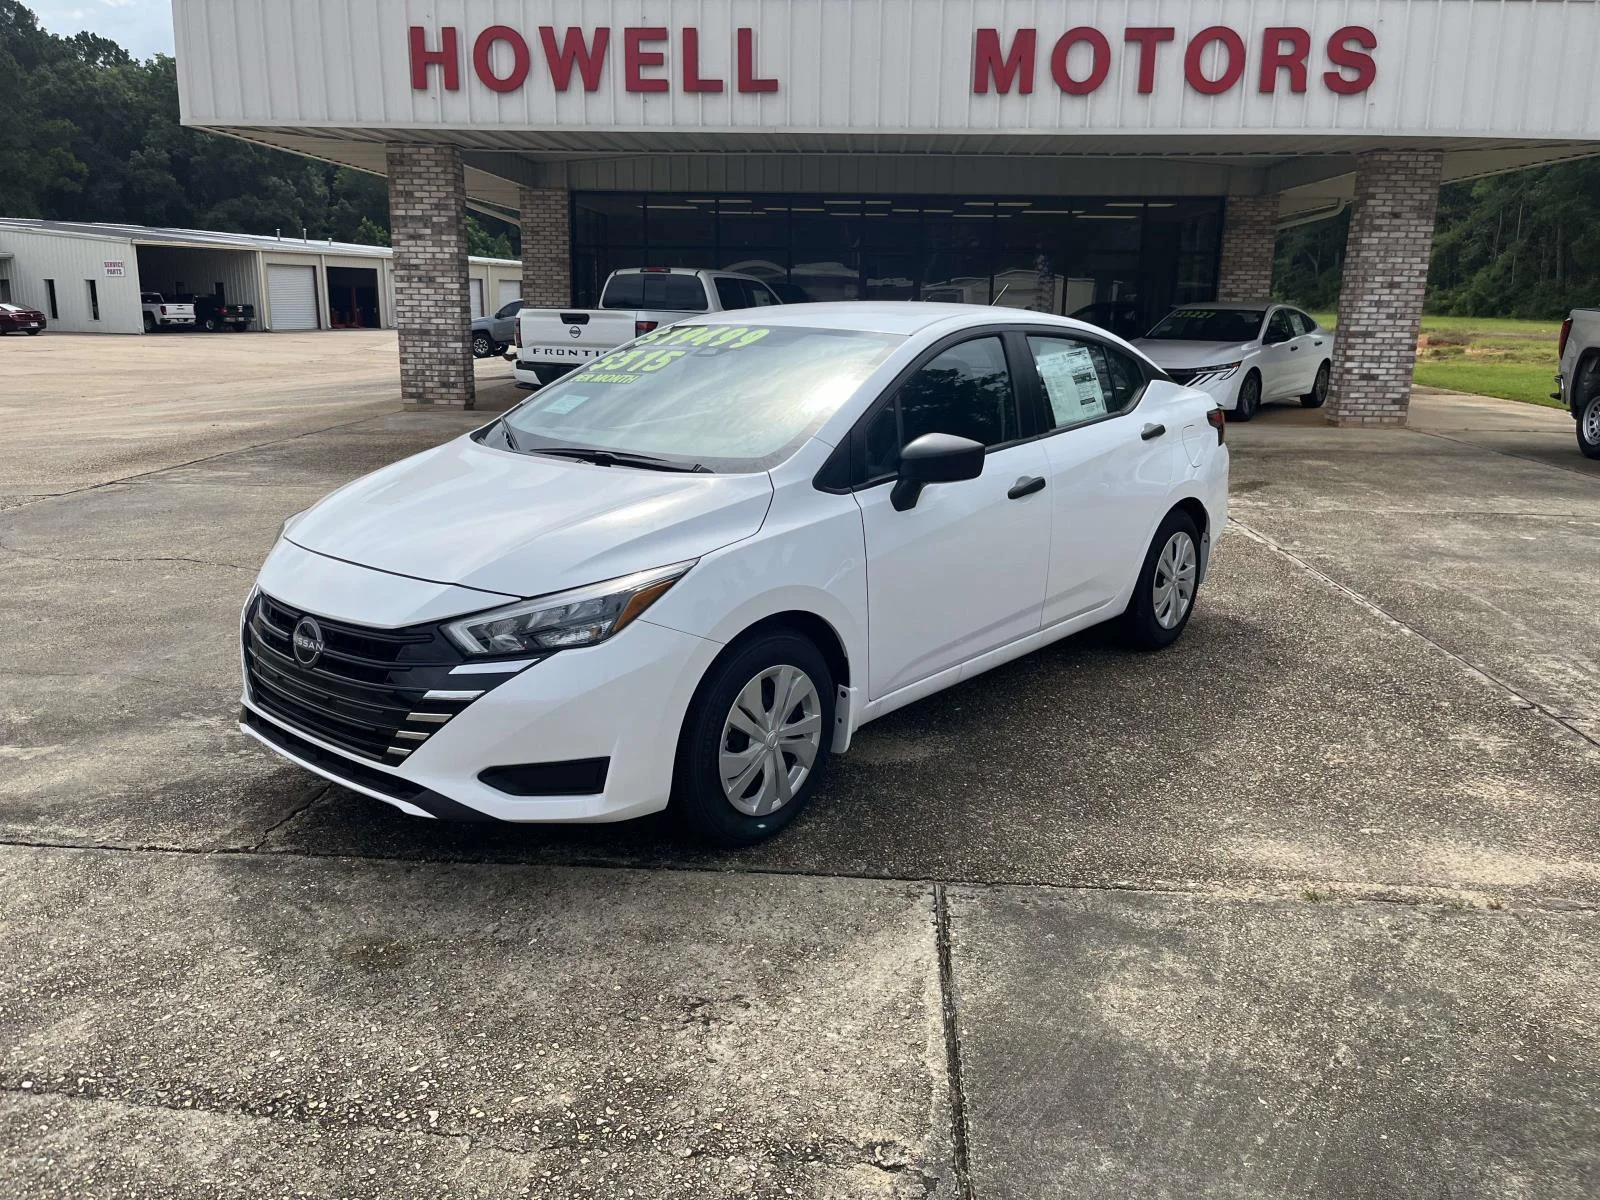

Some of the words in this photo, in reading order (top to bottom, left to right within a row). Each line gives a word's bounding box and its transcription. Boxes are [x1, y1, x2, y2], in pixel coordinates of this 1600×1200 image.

[410, 25, 778, 93] HOWELL
[973, 25, 1378, 95] MOTORS
[589, 350, 687, 372] $315
[596, 374, 640, 384] MONTH
